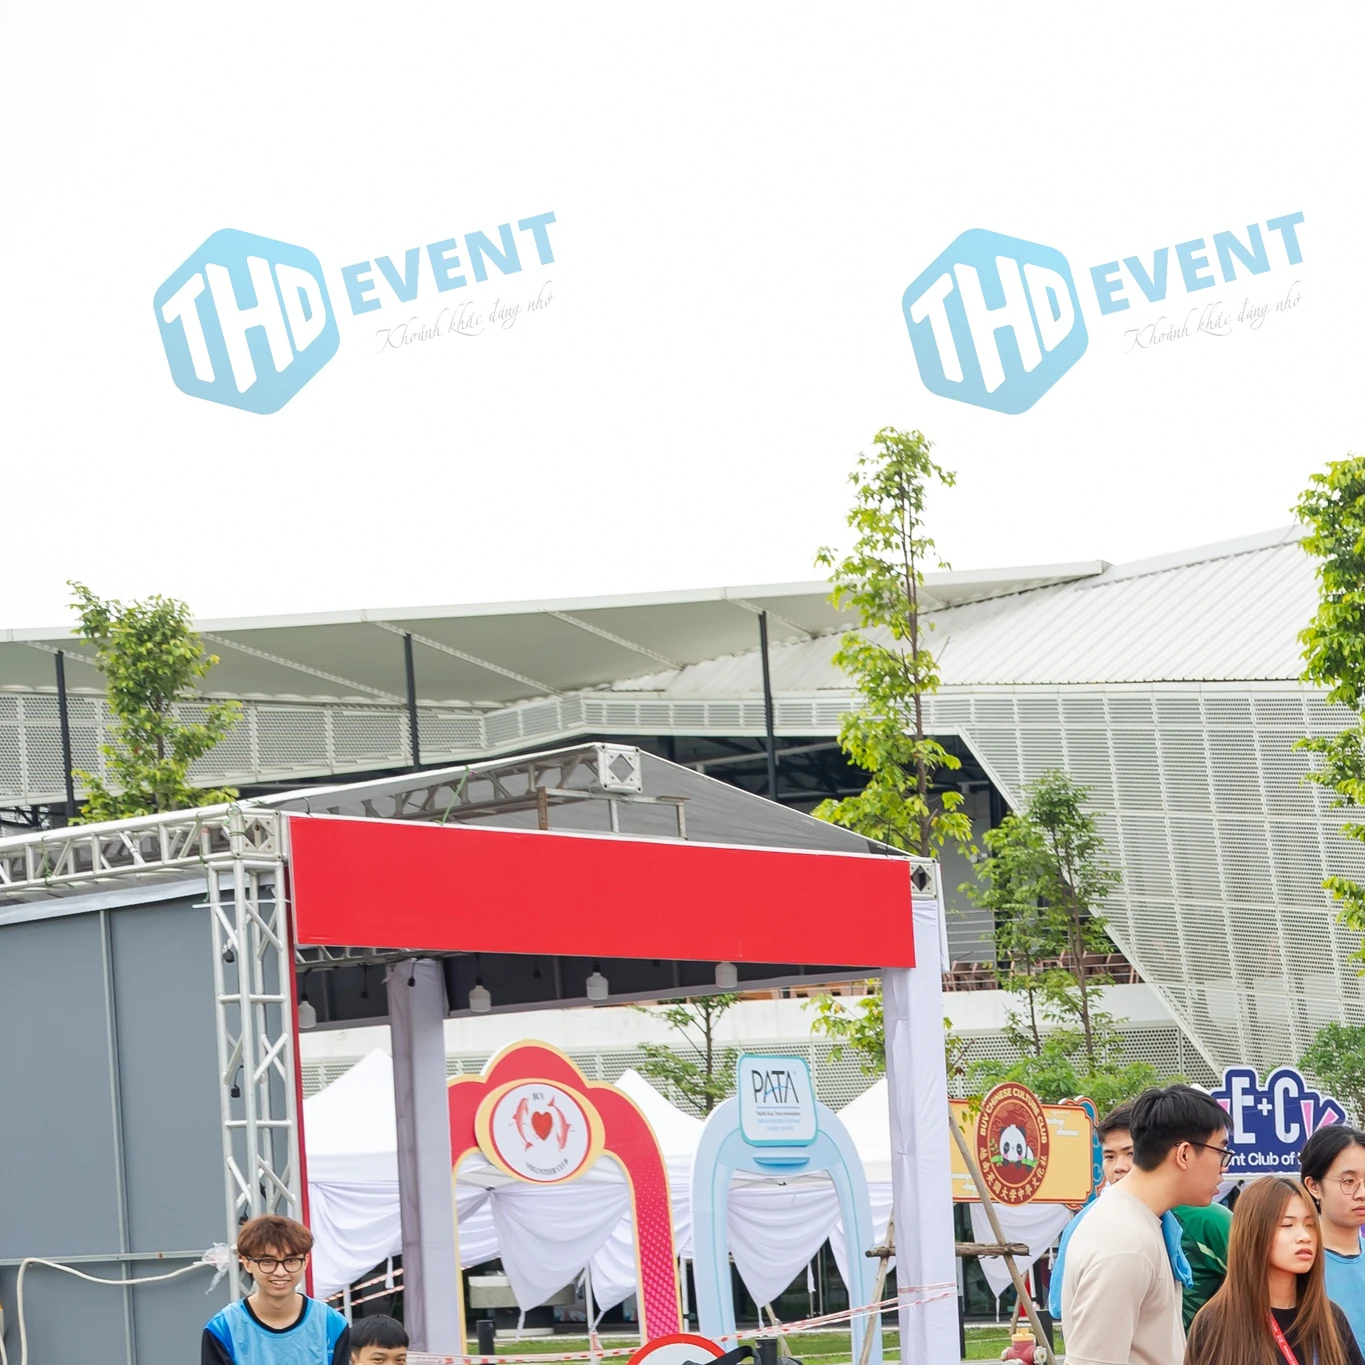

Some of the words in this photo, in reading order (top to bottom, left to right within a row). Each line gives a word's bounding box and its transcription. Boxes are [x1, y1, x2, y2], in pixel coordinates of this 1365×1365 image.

[751, 1069, 800, 1104] PATA
[980, 1113, 990, 1137] BUV
[985, 1088, 1012, 1113] CHINESE
[1012, 1088, 1039, 1116] CULTURE
[1037, 1116, 1048, 1145] CLUB
[1248, 1152, 1279, 1166] Club
[1281, 1151, 1295, 1166] of
